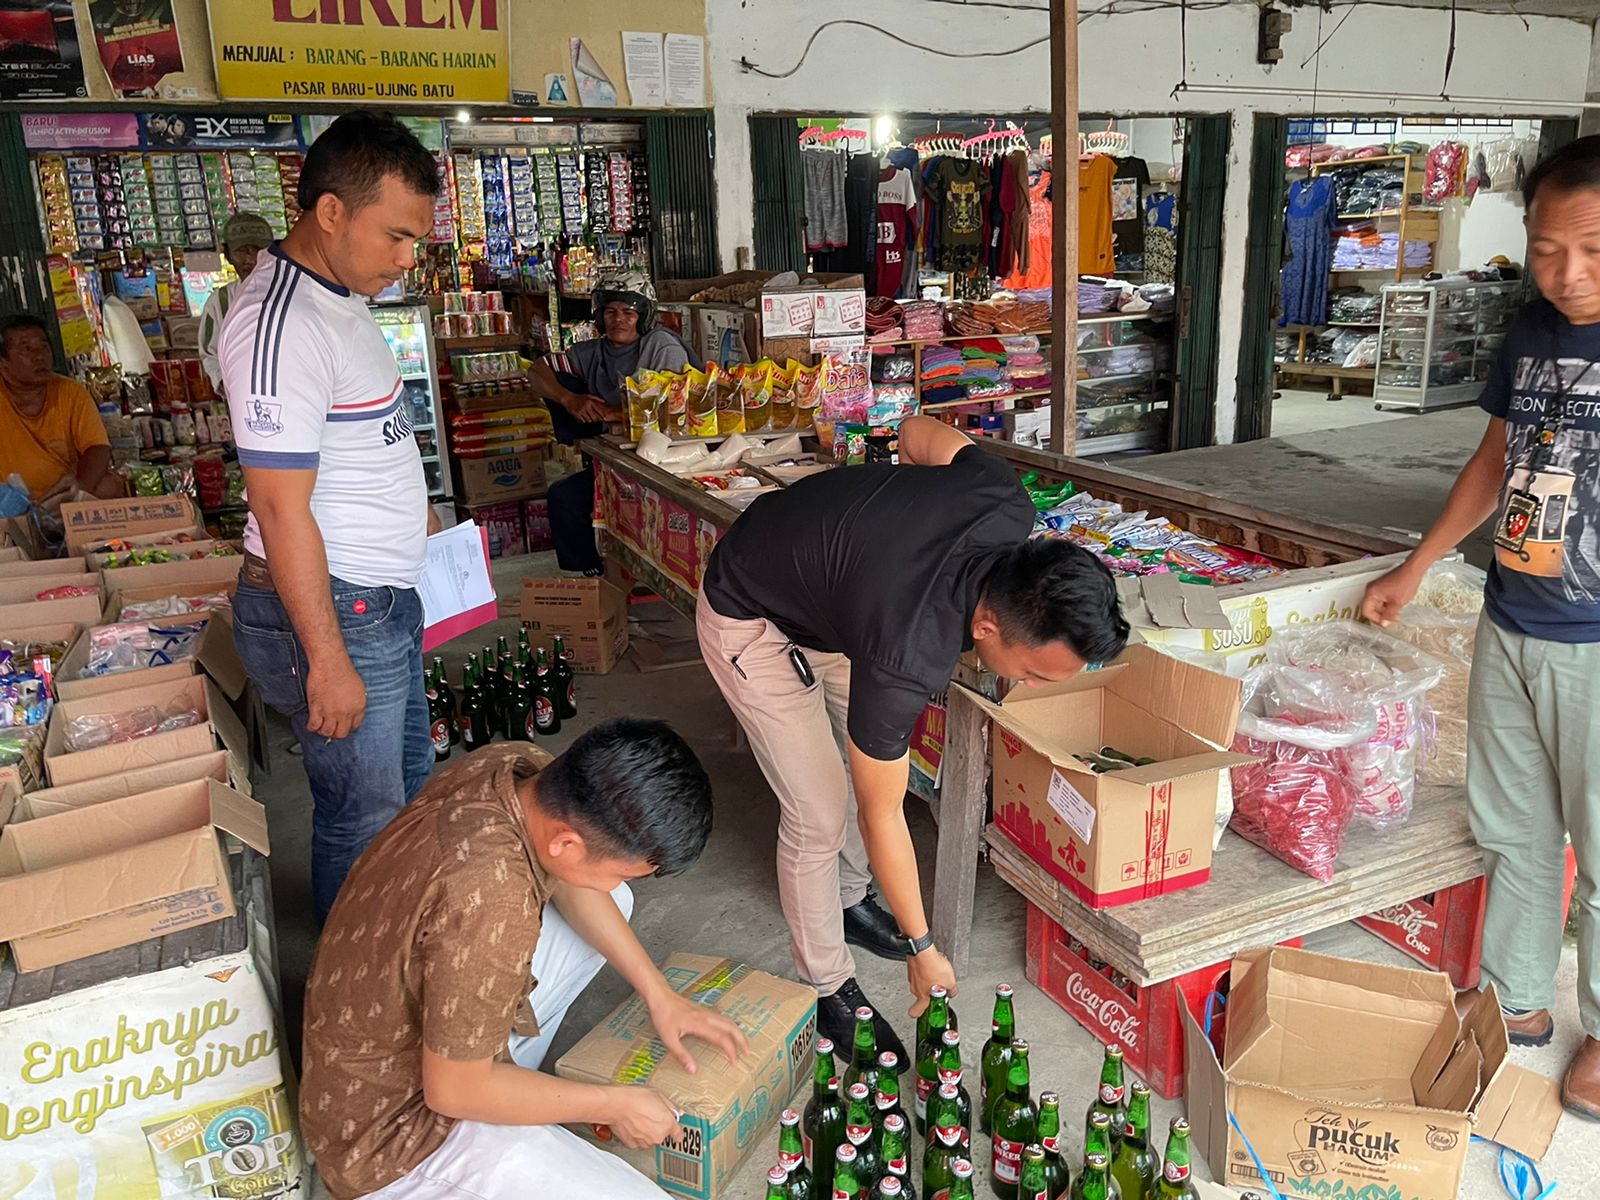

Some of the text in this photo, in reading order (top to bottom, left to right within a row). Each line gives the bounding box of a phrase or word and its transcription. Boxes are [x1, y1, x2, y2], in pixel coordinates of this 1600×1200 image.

[443, 52, 496, 68] HARIAN
[283, 81, 325, 96] PASAR
[423, 84, 455, 97] BATU
[28, 127, 54, 136] SAMPO
[195, 117, 231, 137] 3X
[825, 367, 868, 393] Daia
[487, 457, 522, 475] AQUA
[1212, 623, 1253, 651] SUSU
[1405, 933, 1431, 955] Coke
[21, 998, 240, 1084] Enaknya
[1304, 1107, 1342, 1127] Teh
[166, 1120, 196, 1142] 1.000
[184, 1131, 293, 1190] TOP
[1323, 1141, 1389, 1161] HARUM
